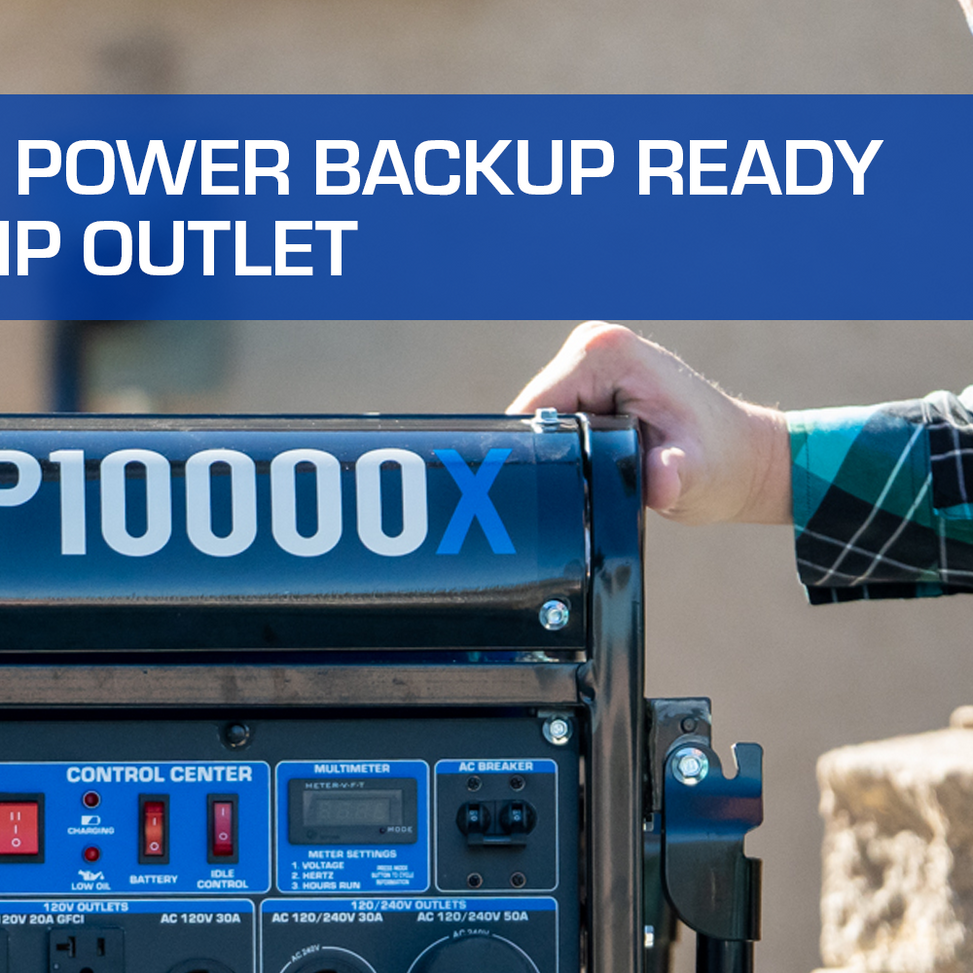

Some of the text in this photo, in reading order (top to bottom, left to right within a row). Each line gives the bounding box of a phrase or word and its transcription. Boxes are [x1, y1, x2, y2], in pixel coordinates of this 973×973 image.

[314, 764, 390, 773] MULTIMETER
[458, 761, 533, 772] AC BREAKER
[67, 766, 252, 782] CONTROL CENTER
[67, 826, 114, 835] CHARGING
[292, 862, 300, 870] 1.
[211, 869, 234, 878] IDLE
[130, 875, 177, 884] BATTERY
[71, 882, 94, 891] LOW
[44, 902, 128, 912] 120V OUTLETS
[351, 900, 467, 911] 120/240V OUTLETS
[30, 914, 53, 924] 20A
[57, 914, 84, 924] GFCI
[161, 914, 240, 923] AC 120V 30A
[272, 912, 383, 922] AC 120/240V 30A
[417, 911, 528, 921] AC 120/240V 50A
[290, 951, 303, 963] AC
